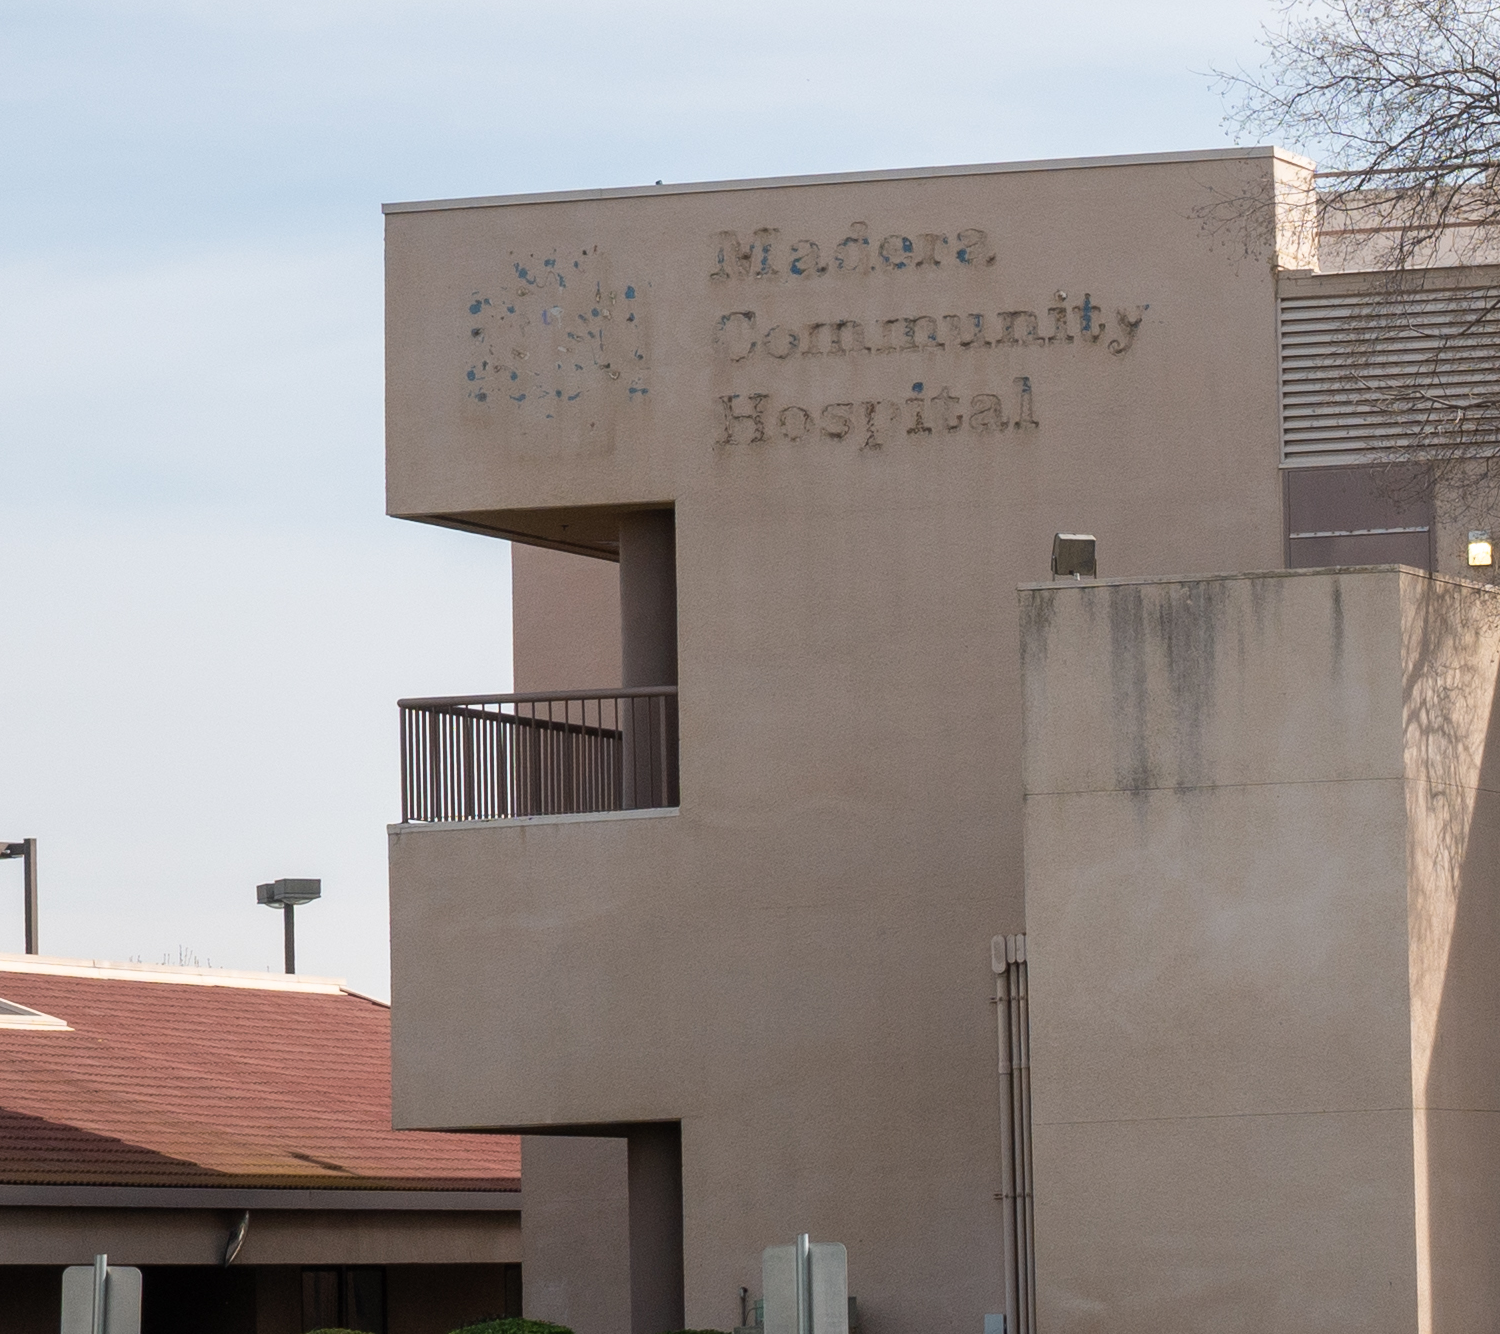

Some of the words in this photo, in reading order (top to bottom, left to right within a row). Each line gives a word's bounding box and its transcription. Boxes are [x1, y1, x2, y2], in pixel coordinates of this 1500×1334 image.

[710, 221, 997, 281] Madera
[713, 290, 1150, 363] Community
[713, 376, 1041, 453] Hospital
